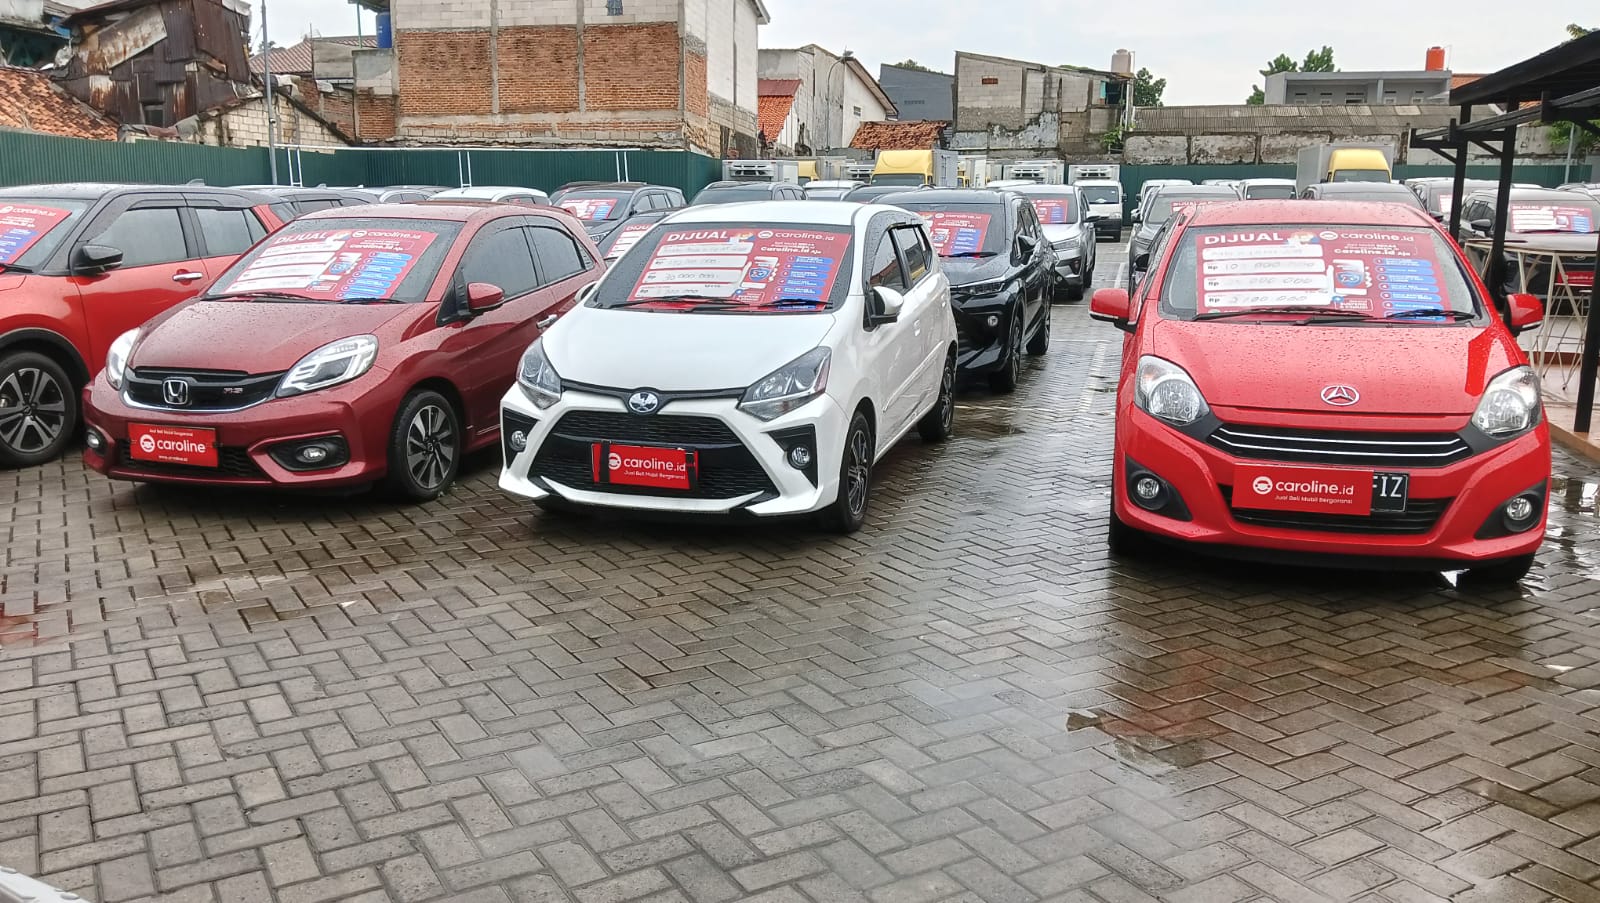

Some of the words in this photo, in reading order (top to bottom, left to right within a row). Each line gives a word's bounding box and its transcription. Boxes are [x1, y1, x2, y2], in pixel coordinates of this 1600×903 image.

[274, 232, 328, 244] DIJUAL
[368, 231, 421, 239] caroline.id
[667, 231, 728, 241] DIJUAL
[775, 232, 835, 241] caroline.id
[1204, 232, 1284, 244] DIJUAL
[1340, 232, 1414, 242] caroline.id
[157, 439, 206, 453] caroline
[623, 457, 686, 471] caroline.id
[1275, 481, 1354, 495] caroline.id
